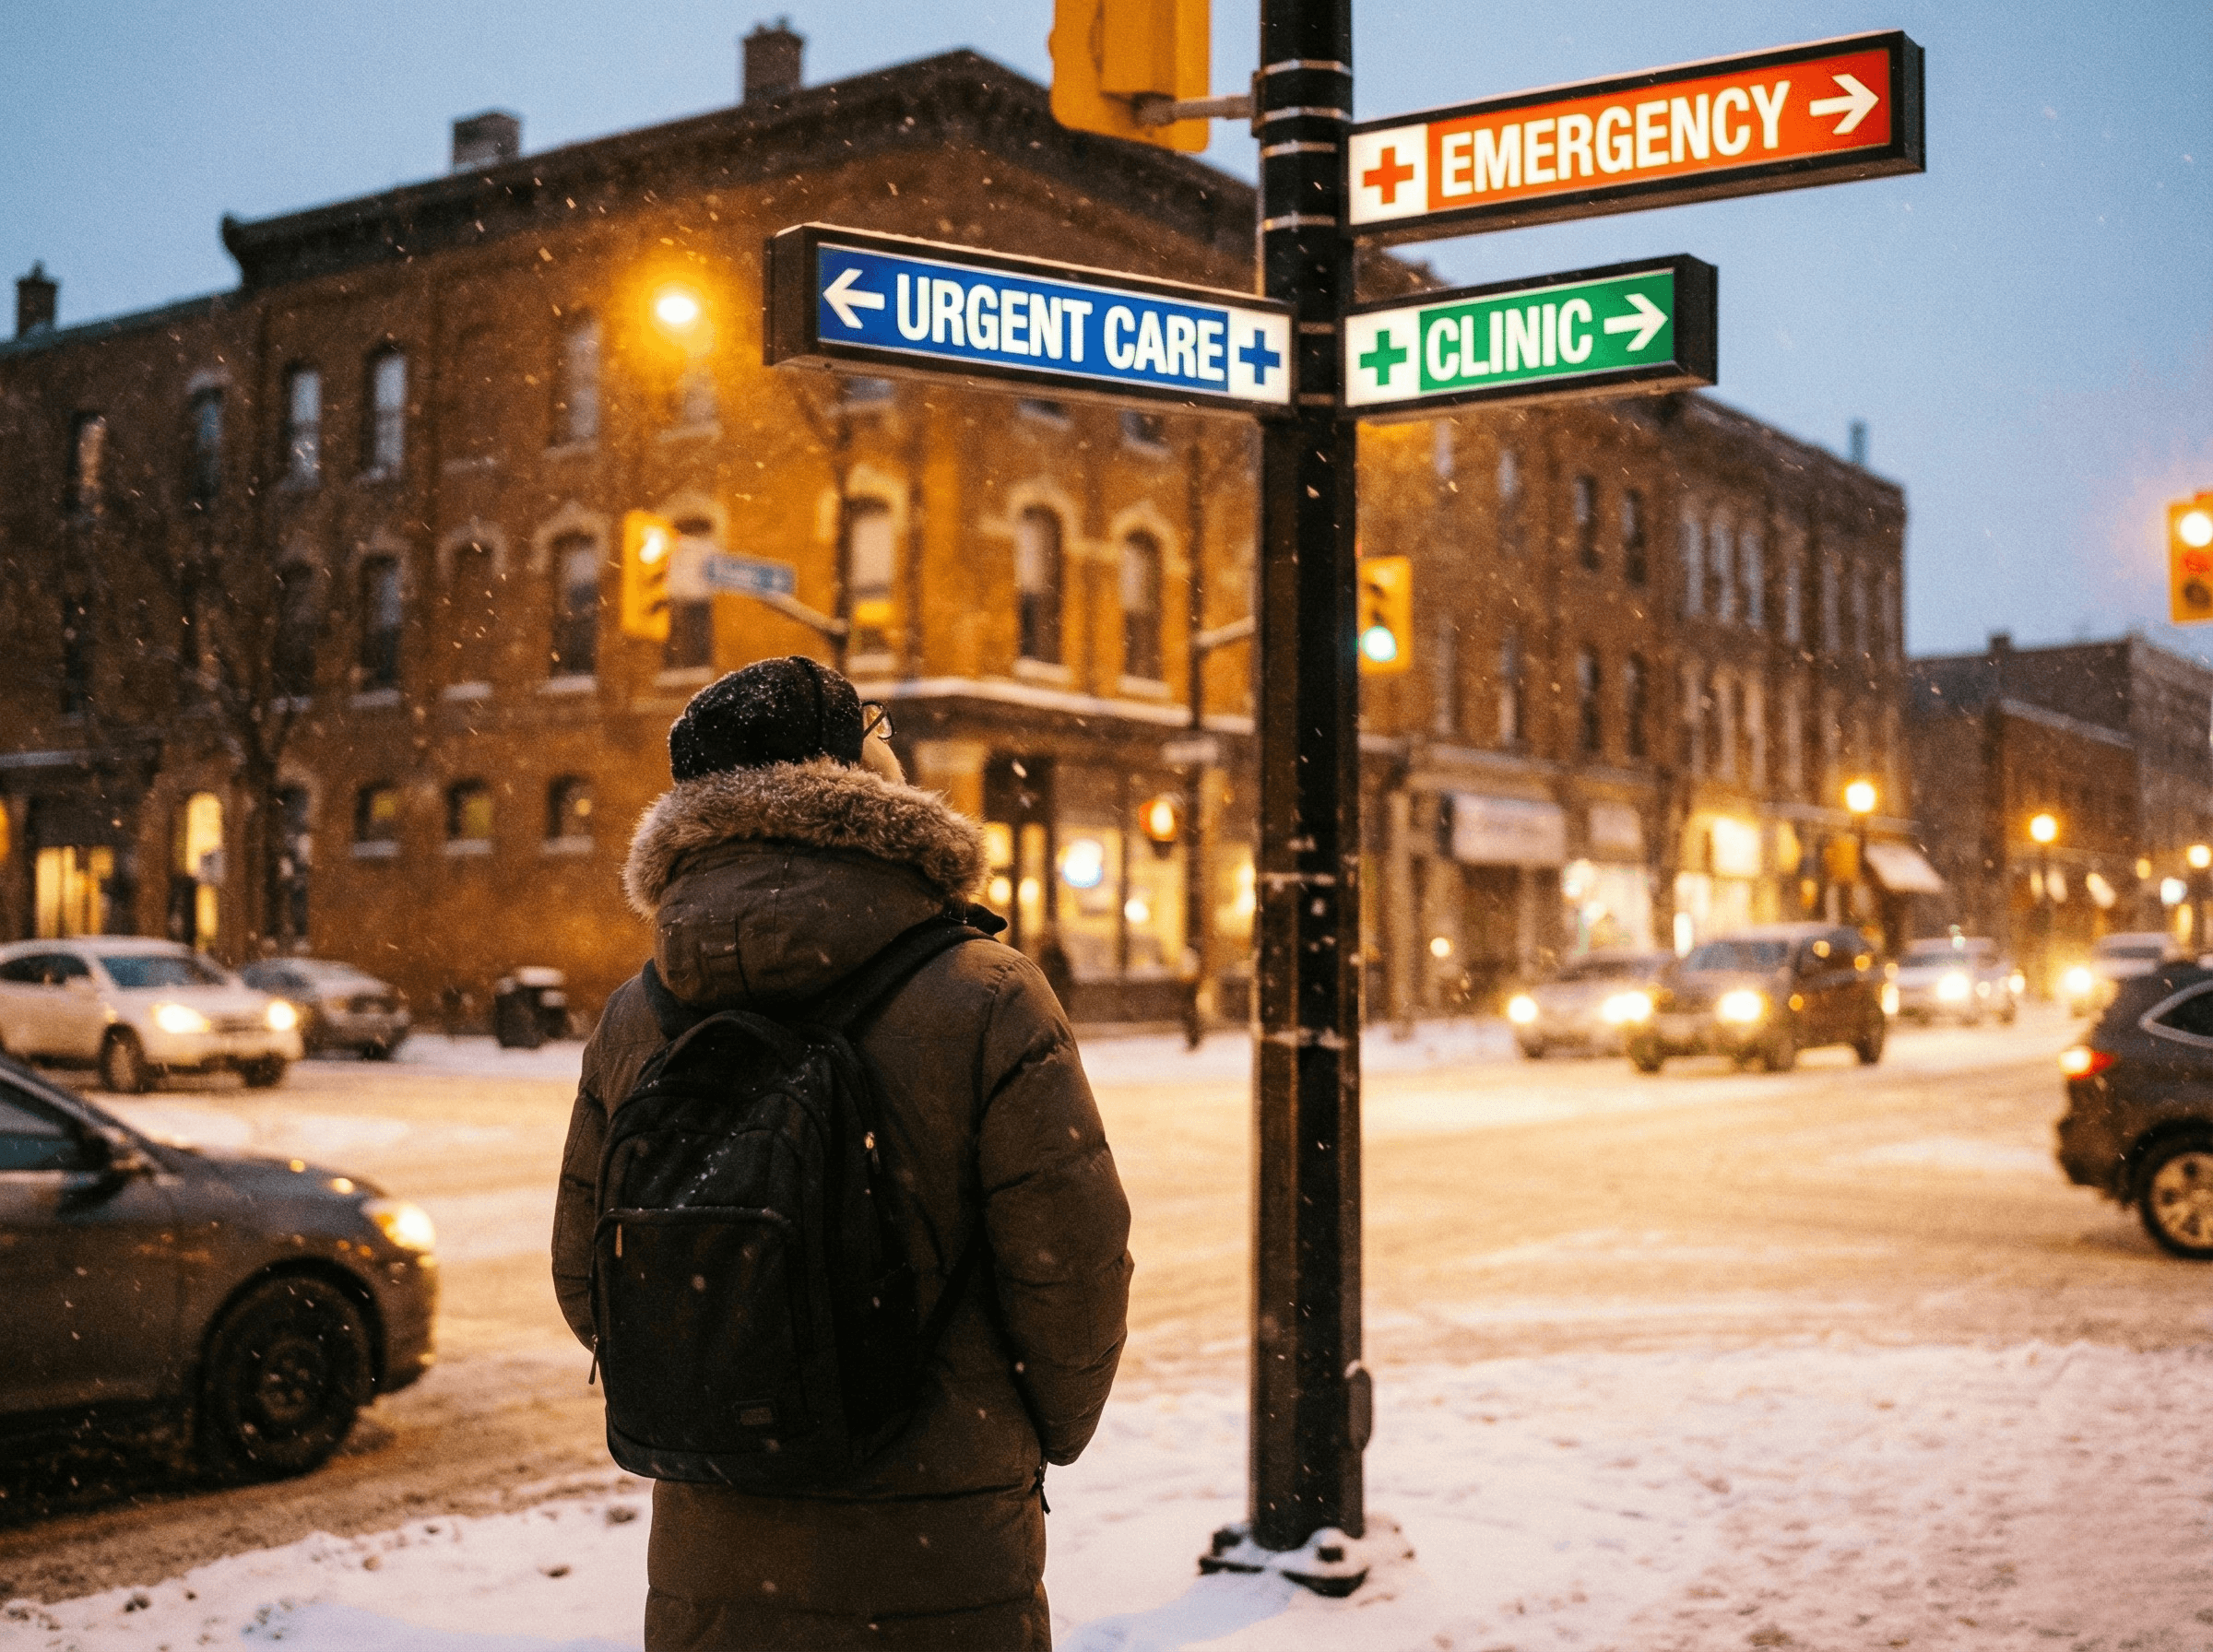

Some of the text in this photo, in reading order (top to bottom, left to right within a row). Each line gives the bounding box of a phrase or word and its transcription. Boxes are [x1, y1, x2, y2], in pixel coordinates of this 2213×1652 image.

[1440, 80, 1791, 198] EMERGENCY
[896, 273, 1225, 383] URGENT CARE
[1425, 297, 1594, 383] CLINIC
